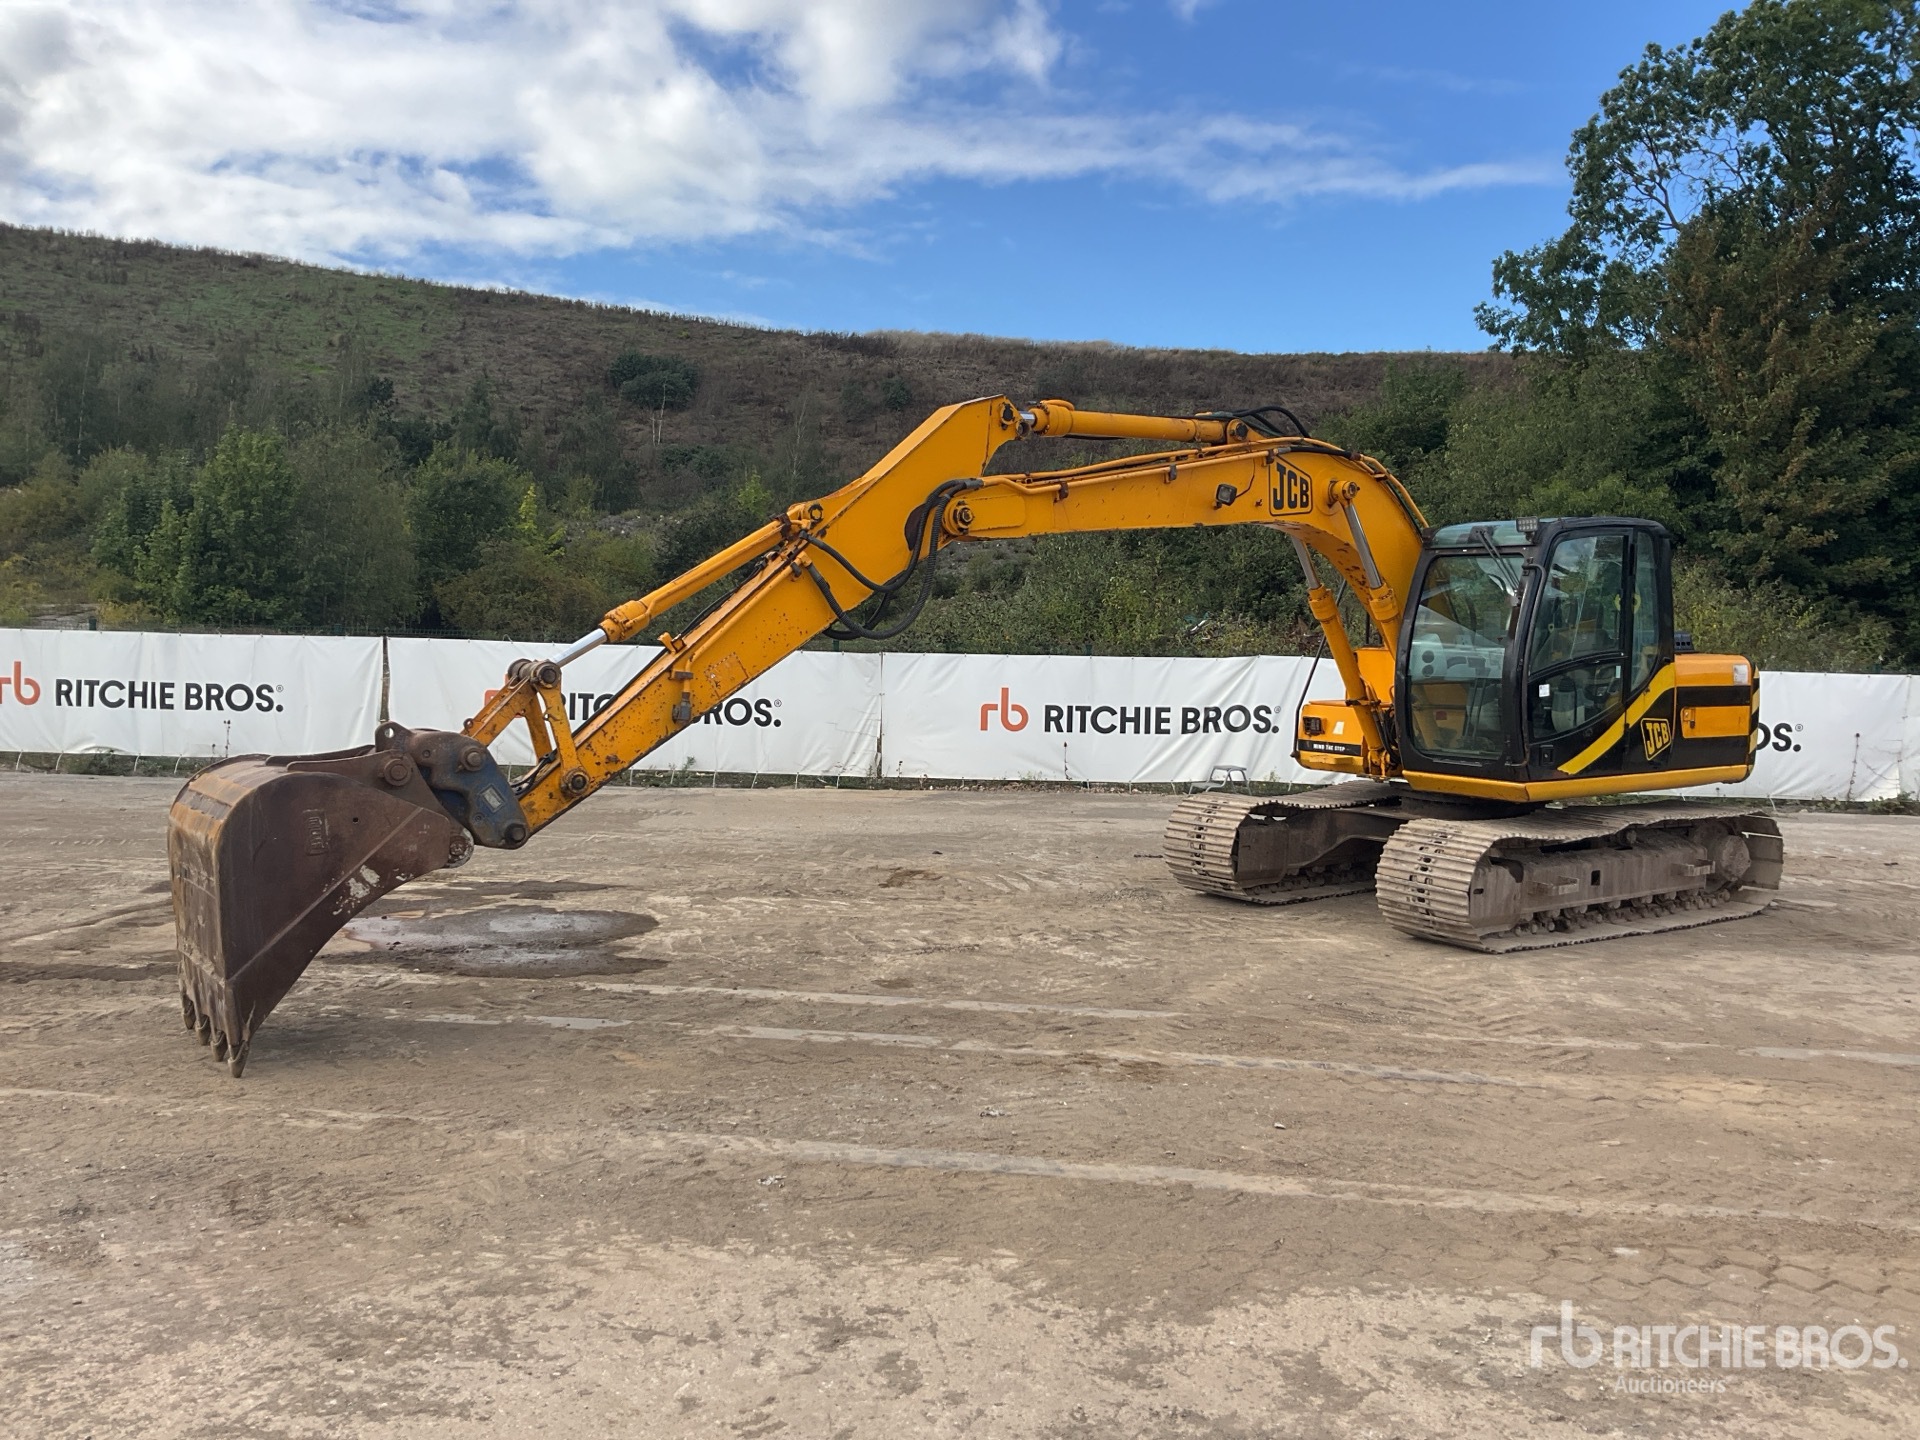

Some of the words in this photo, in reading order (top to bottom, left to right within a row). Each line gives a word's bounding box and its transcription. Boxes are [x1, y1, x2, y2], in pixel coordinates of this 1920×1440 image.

[1273, 462, 1309, 510] JCB
[55, 678, 175, 711] RITCHIE
[1044, 704, 1171, 735] RITCHIE
[1645, 721, 1670, 755] JCB
